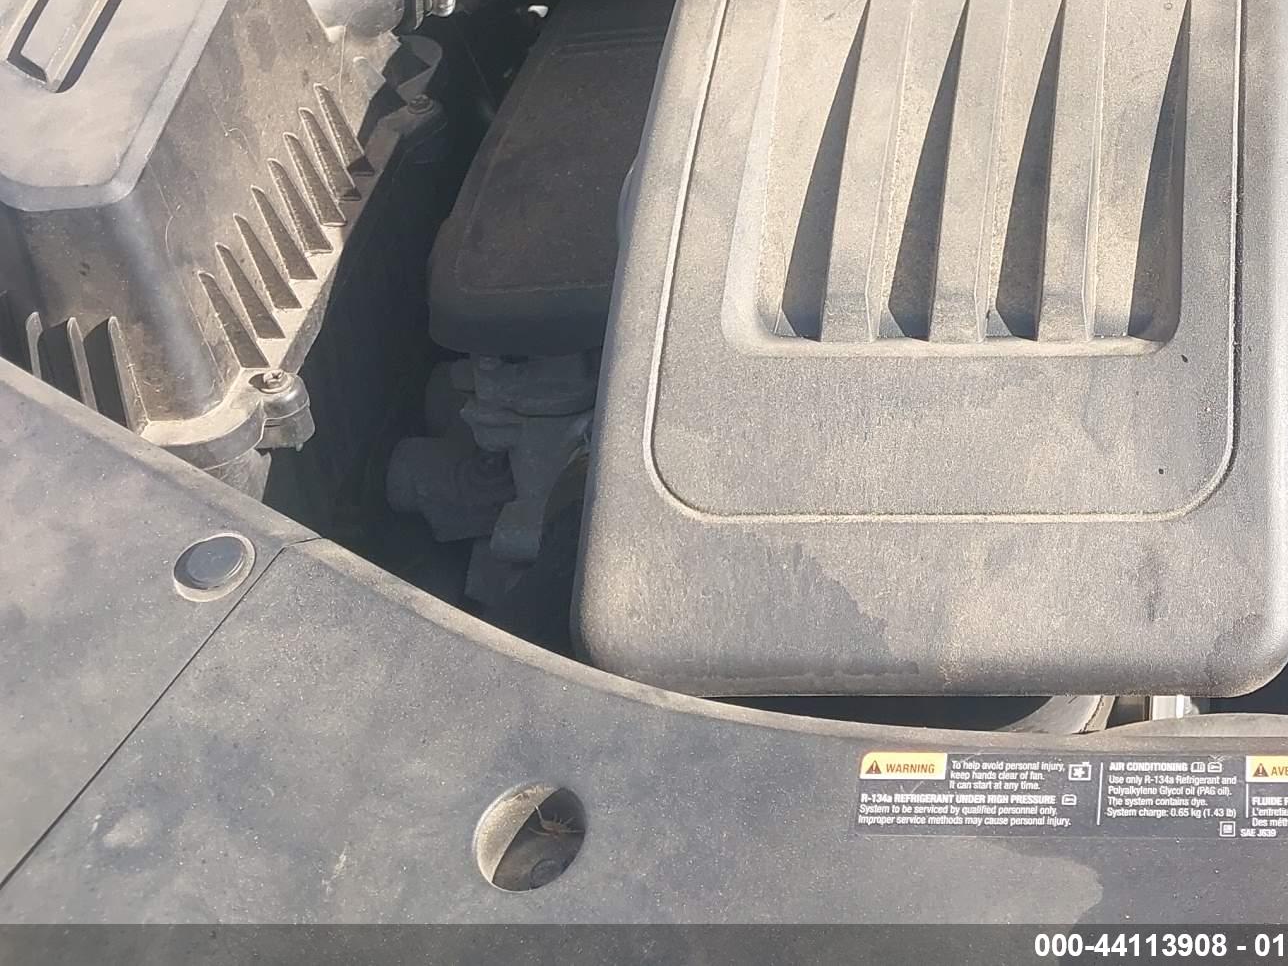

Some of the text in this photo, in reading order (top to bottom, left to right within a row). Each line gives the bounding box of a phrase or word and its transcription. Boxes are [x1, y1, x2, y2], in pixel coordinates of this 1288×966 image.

[886, 763, 935, 774] WARNING
[951, 761, 961, 769] To
[963, 761, 980, 771] help
[982, 762, 1004, 770] avoid
[1005, 762, 1040, 772] personal
[1109, 762, 1188, 772] AIR CONDITIONING
[950, 771, 1045, 780] keep hands clear of fan.
[973, 781, 992, 789] start
[1004, 783, 1019, 791] any
[1020, 781, 1040, 790] time.
[1108, 776, 1237, 786] Use only R-134a Refrigerant and
[1108, 786, 1157, 796] Polyalkylene
[1159, 786, 1184, 796] Glycol
[1186, 786, 1195, 795] oil
[1197, 786, 1216, 796] (PAG
[861, 794, 1057, 804] R-134a REFRIGERANT UNDER HIGH PRESSURE
[1108, 796, 1123, 806] The
[1125, 797, 1153, 807] system
[1155, 797, 1189, 806] contains
[1252, 797, 1283, 806] FLUIDE
[859, 804, 890, 814] System
[892, 805, 900, 813] to
[902, 805, 912, 813] be
[914, 805, 948, 813] serviced
[950, 805, 960, 815] by
[962, 805, 996, 815] qualified
[998, 806, 1037, 816] personnel
[1107, 807, 1237, 818] System charge: 0.65 kg (1.43 lb)
[858, 814, 1072, 827] Improper service methods may cause personal injury.
[1252, 818, 1268, 827] Des
[1240, 829, 1256, 837] SAE
